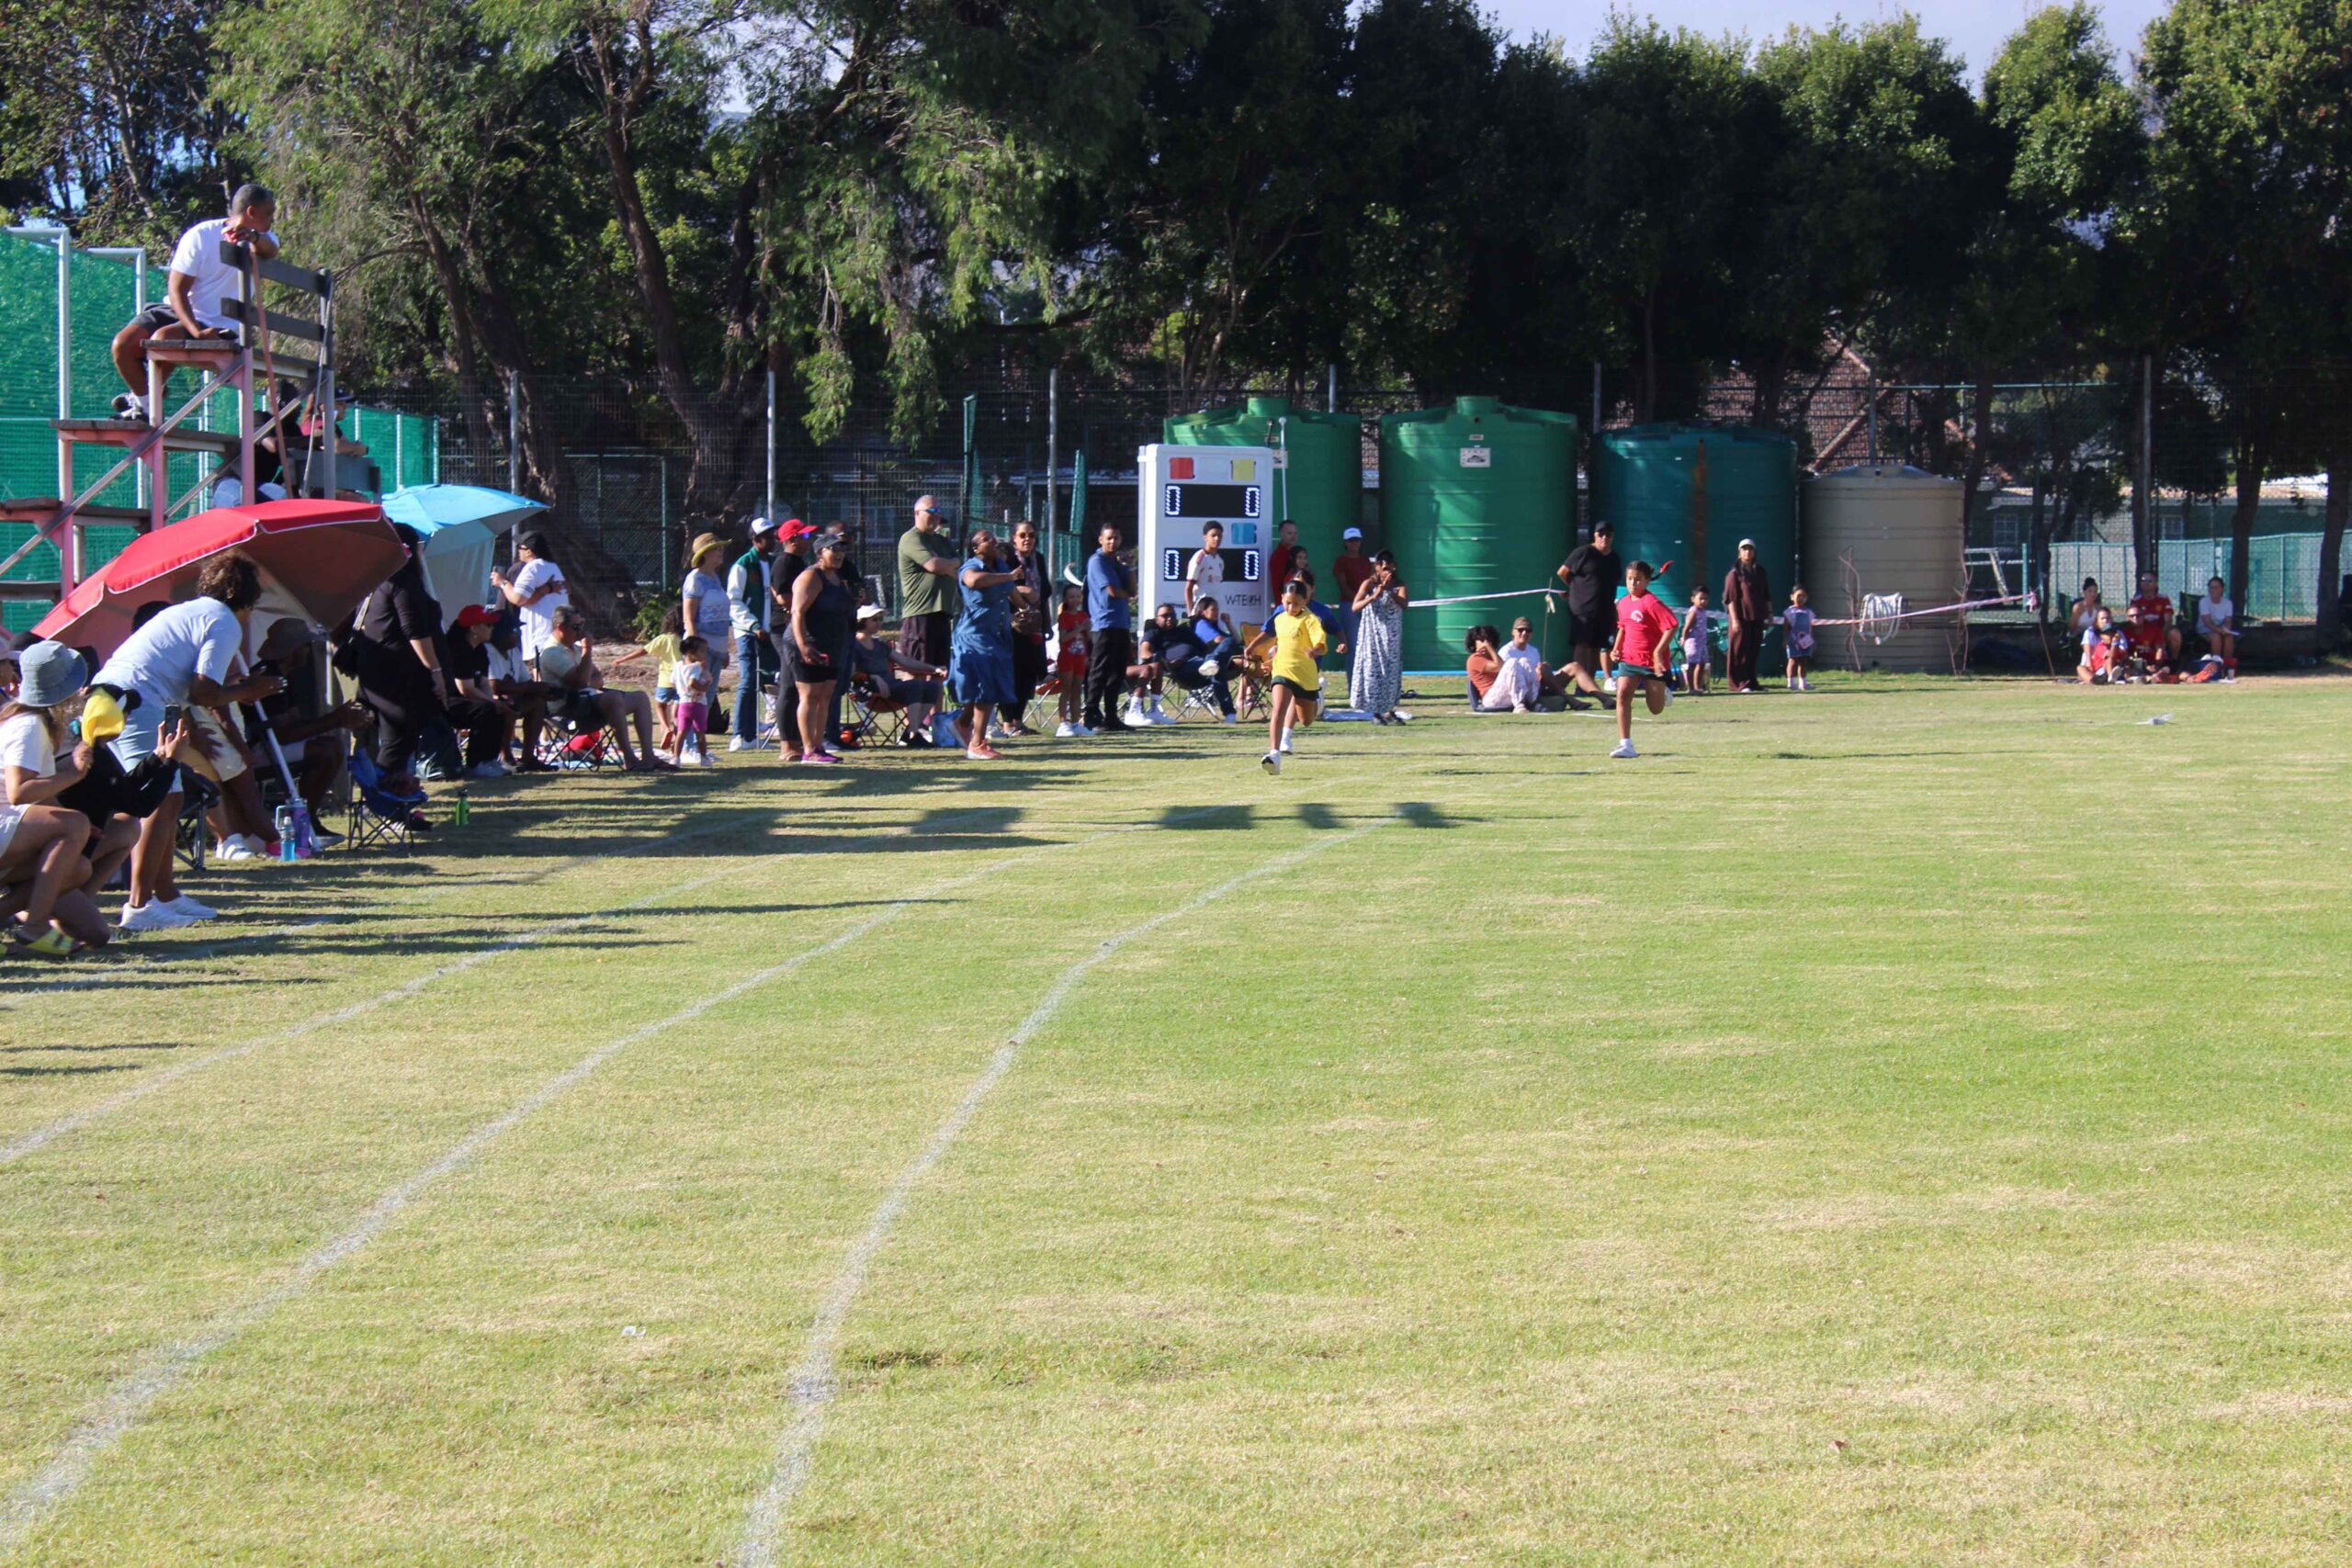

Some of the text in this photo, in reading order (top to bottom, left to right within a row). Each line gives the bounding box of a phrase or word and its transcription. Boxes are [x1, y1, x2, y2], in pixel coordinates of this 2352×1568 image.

[1165, 485, 1260, 516] 0 0
[1164, 549, 1259, 580] 0 0
